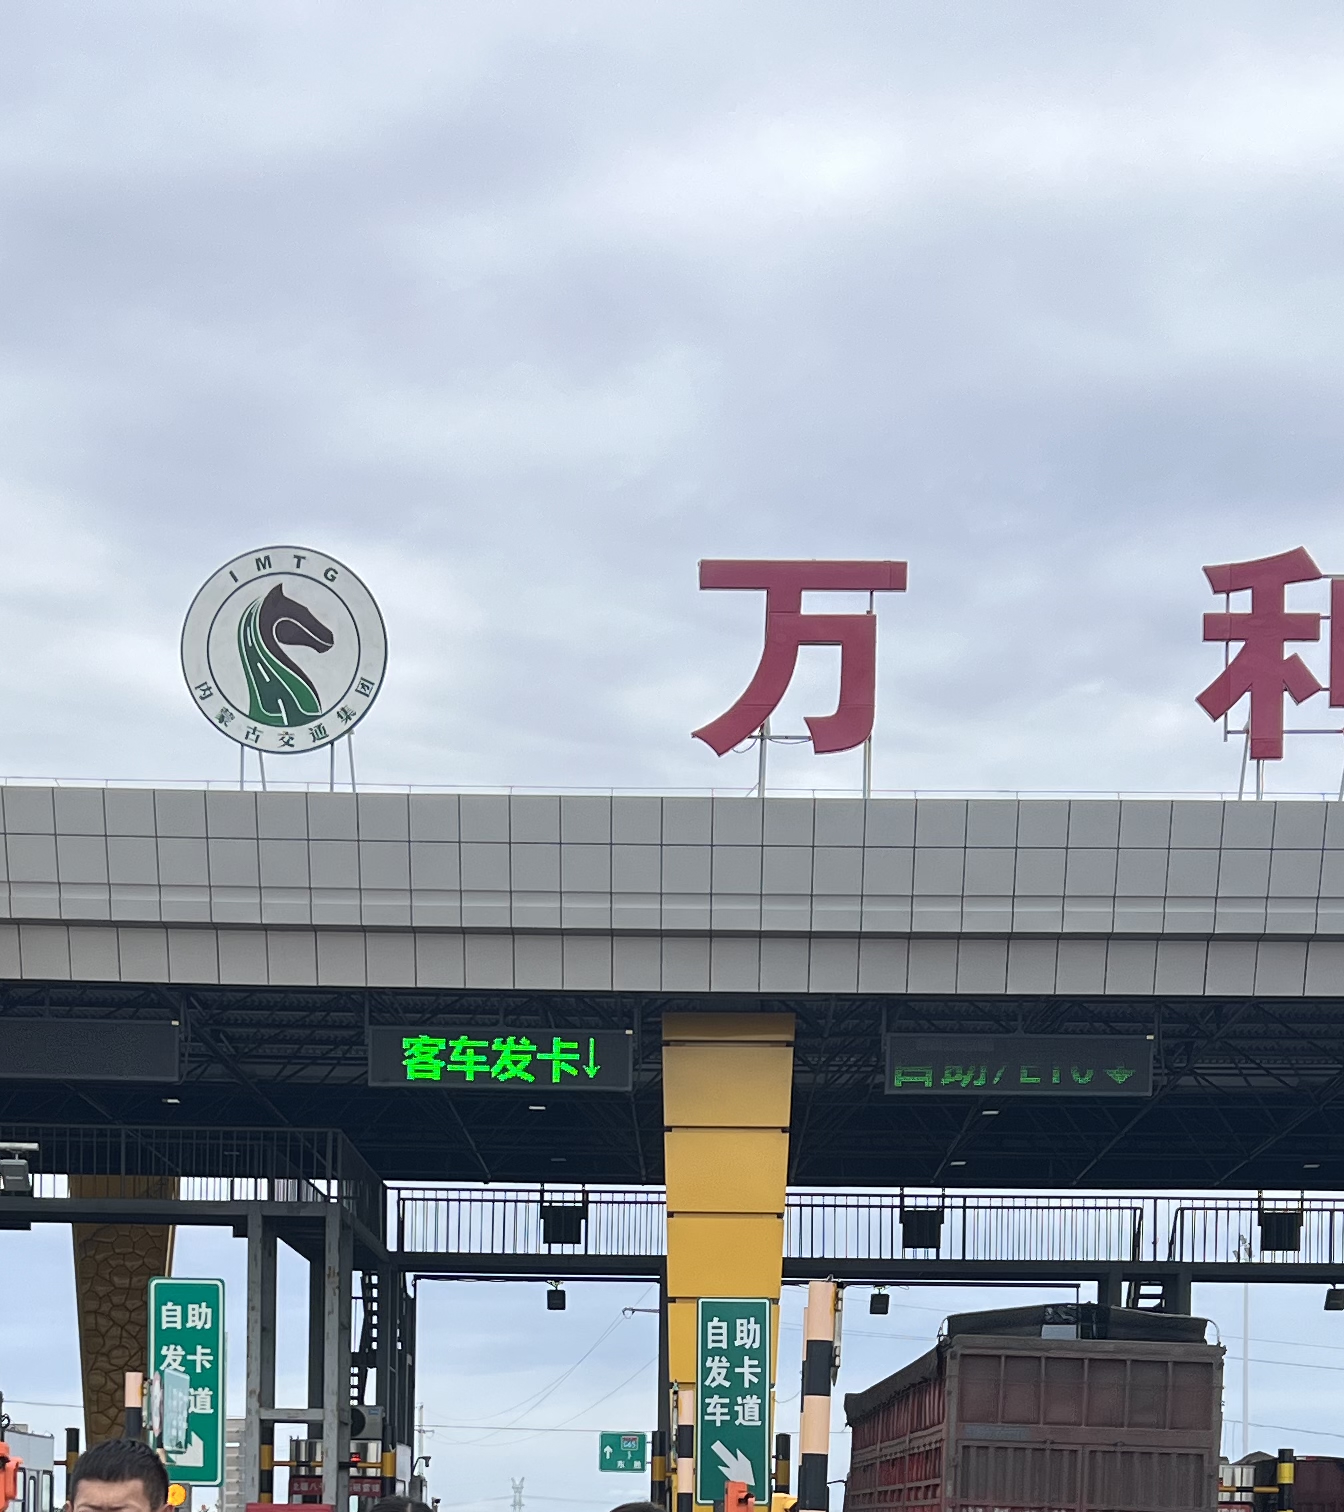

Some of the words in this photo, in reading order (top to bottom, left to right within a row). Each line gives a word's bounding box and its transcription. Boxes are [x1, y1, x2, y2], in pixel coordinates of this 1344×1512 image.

[228, 553, 340, 584] IMTG
[193, 675, 376, 749] 内蒙古交通集团
[400, 1034, 581, 1084] 客车发卡
[160, 1301, 213, 1330] 自助
[706, 1316, 762, 1350] 自助
[159, 1344, 214, 1374] 发卡
[703, 1355, 763, 1389] 发卡
[186, 1386, 215, 1415] 道
[703, 1394, 763, 1427] 车道
